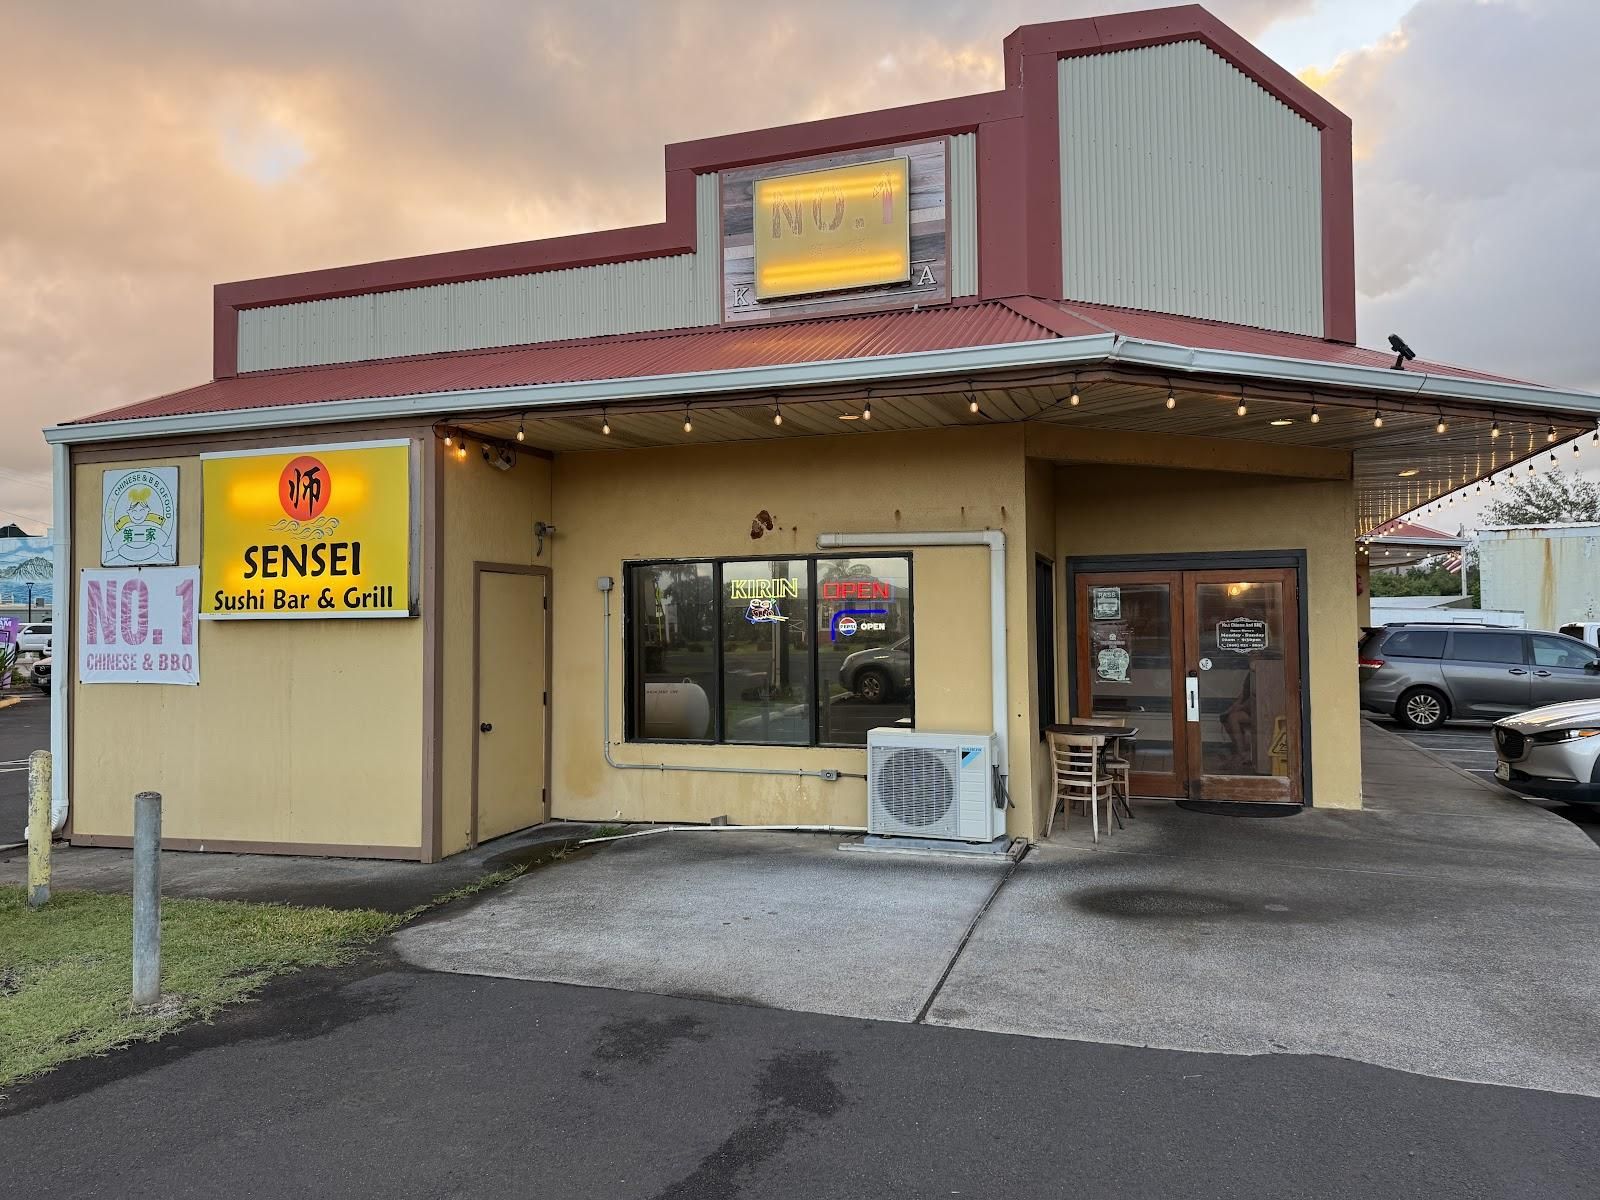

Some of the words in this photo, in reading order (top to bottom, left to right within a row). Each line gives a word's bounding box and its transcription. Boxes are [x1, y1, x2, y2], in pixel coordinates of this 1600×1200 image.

[771, 184, 865, 239] NO.
[872, 171, 894, 225] 1
[114, 474, 141, 497] CHINESE
[142, 474, 148, 482] &
[162, 493, 172, 519] FOOD
[123, 528, 157, 542] 第一家
[244, 541, 361, 579] SENSEI
[214, 588, 265, 611] Sushi
[274, 589, 310, 610] Bar
[317, 587, 335, 609] &
[343, 586, 393, 608] Grill
[731, 578, 798, 599] KIRIN
[823, 582, 889, 599] OPEN
[87, 579, 163, 646] NO.
[175, 579, 194, 645] 1
[860, 622, 886, 631] OPEN
[87, 653, 137, 671] CHINESE
[142, 652, 153, 671] &
[159, 653, 193, 674] BBQ
